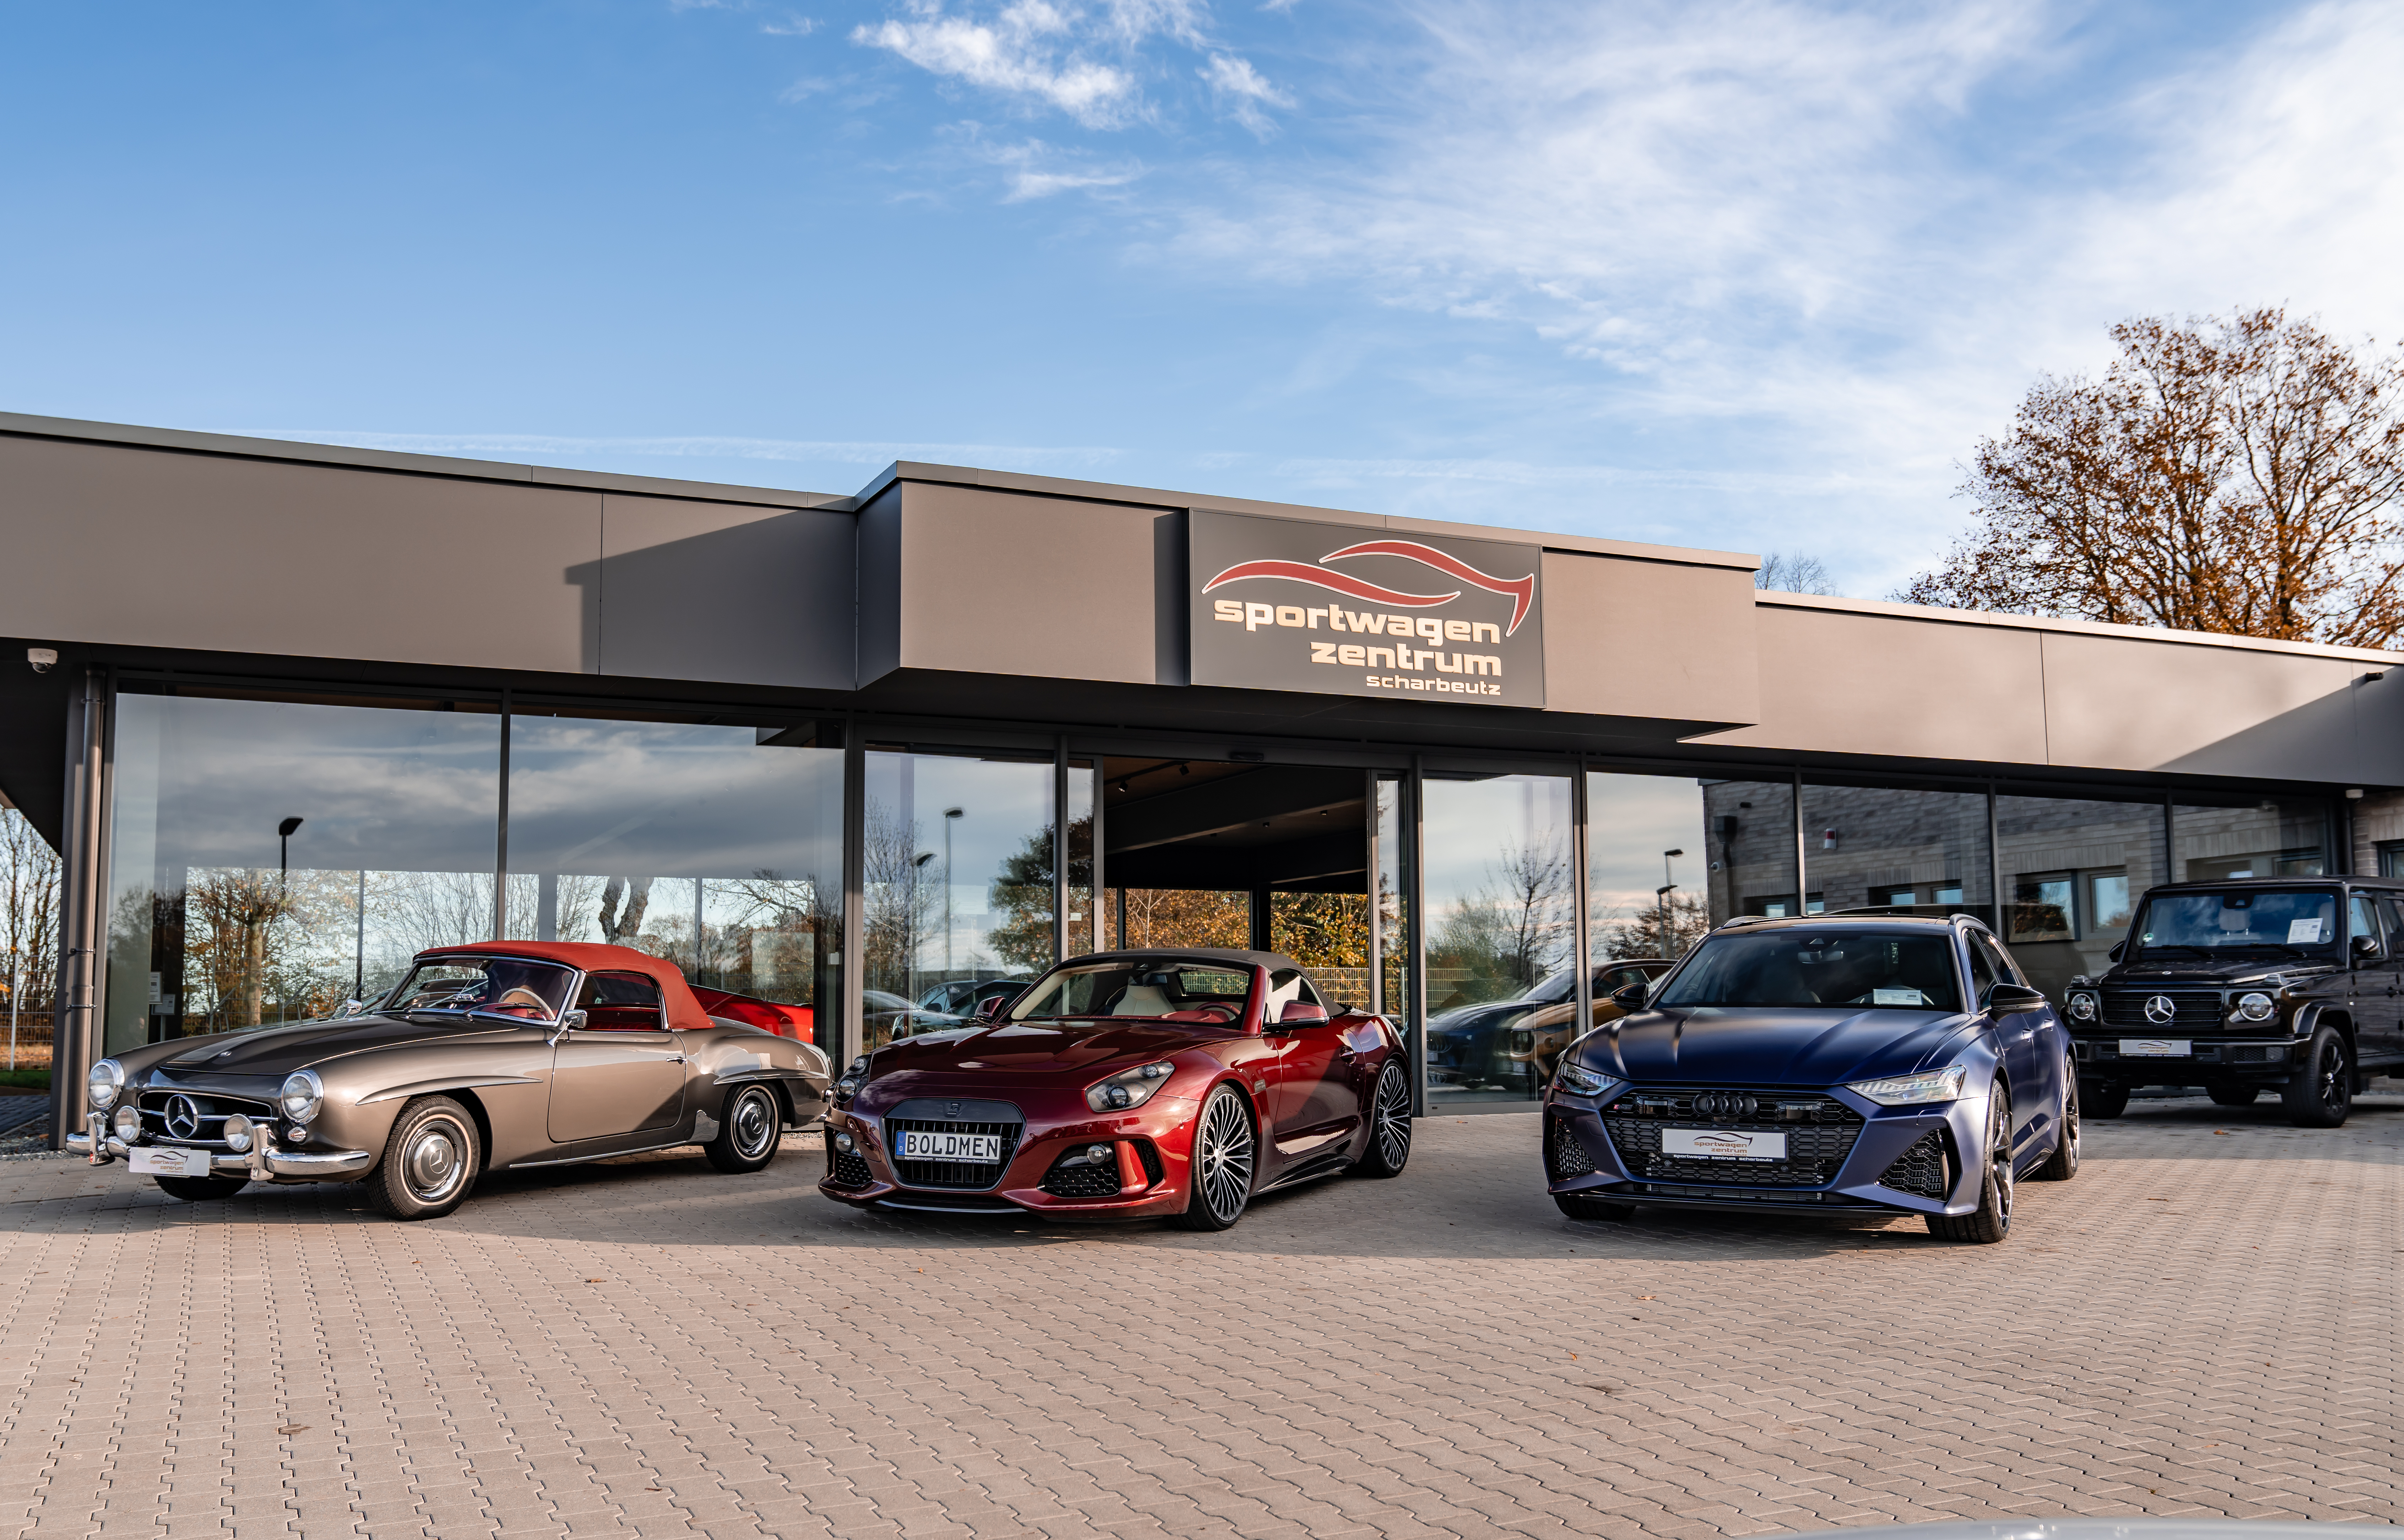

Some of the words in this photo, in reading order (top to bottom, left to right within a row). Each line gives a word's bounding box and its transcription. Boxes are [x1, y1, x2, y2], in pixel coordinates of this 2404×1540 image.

[1214, 600, 1500, 646] sportwagen
[1310, 641, 1502, 677] zentrum
[1366, 675, 1501, 695] scharbeutz
[411, 1110, 429, 1128] MA-1
[906, 1135, 998, 1157] BOLDMEN
